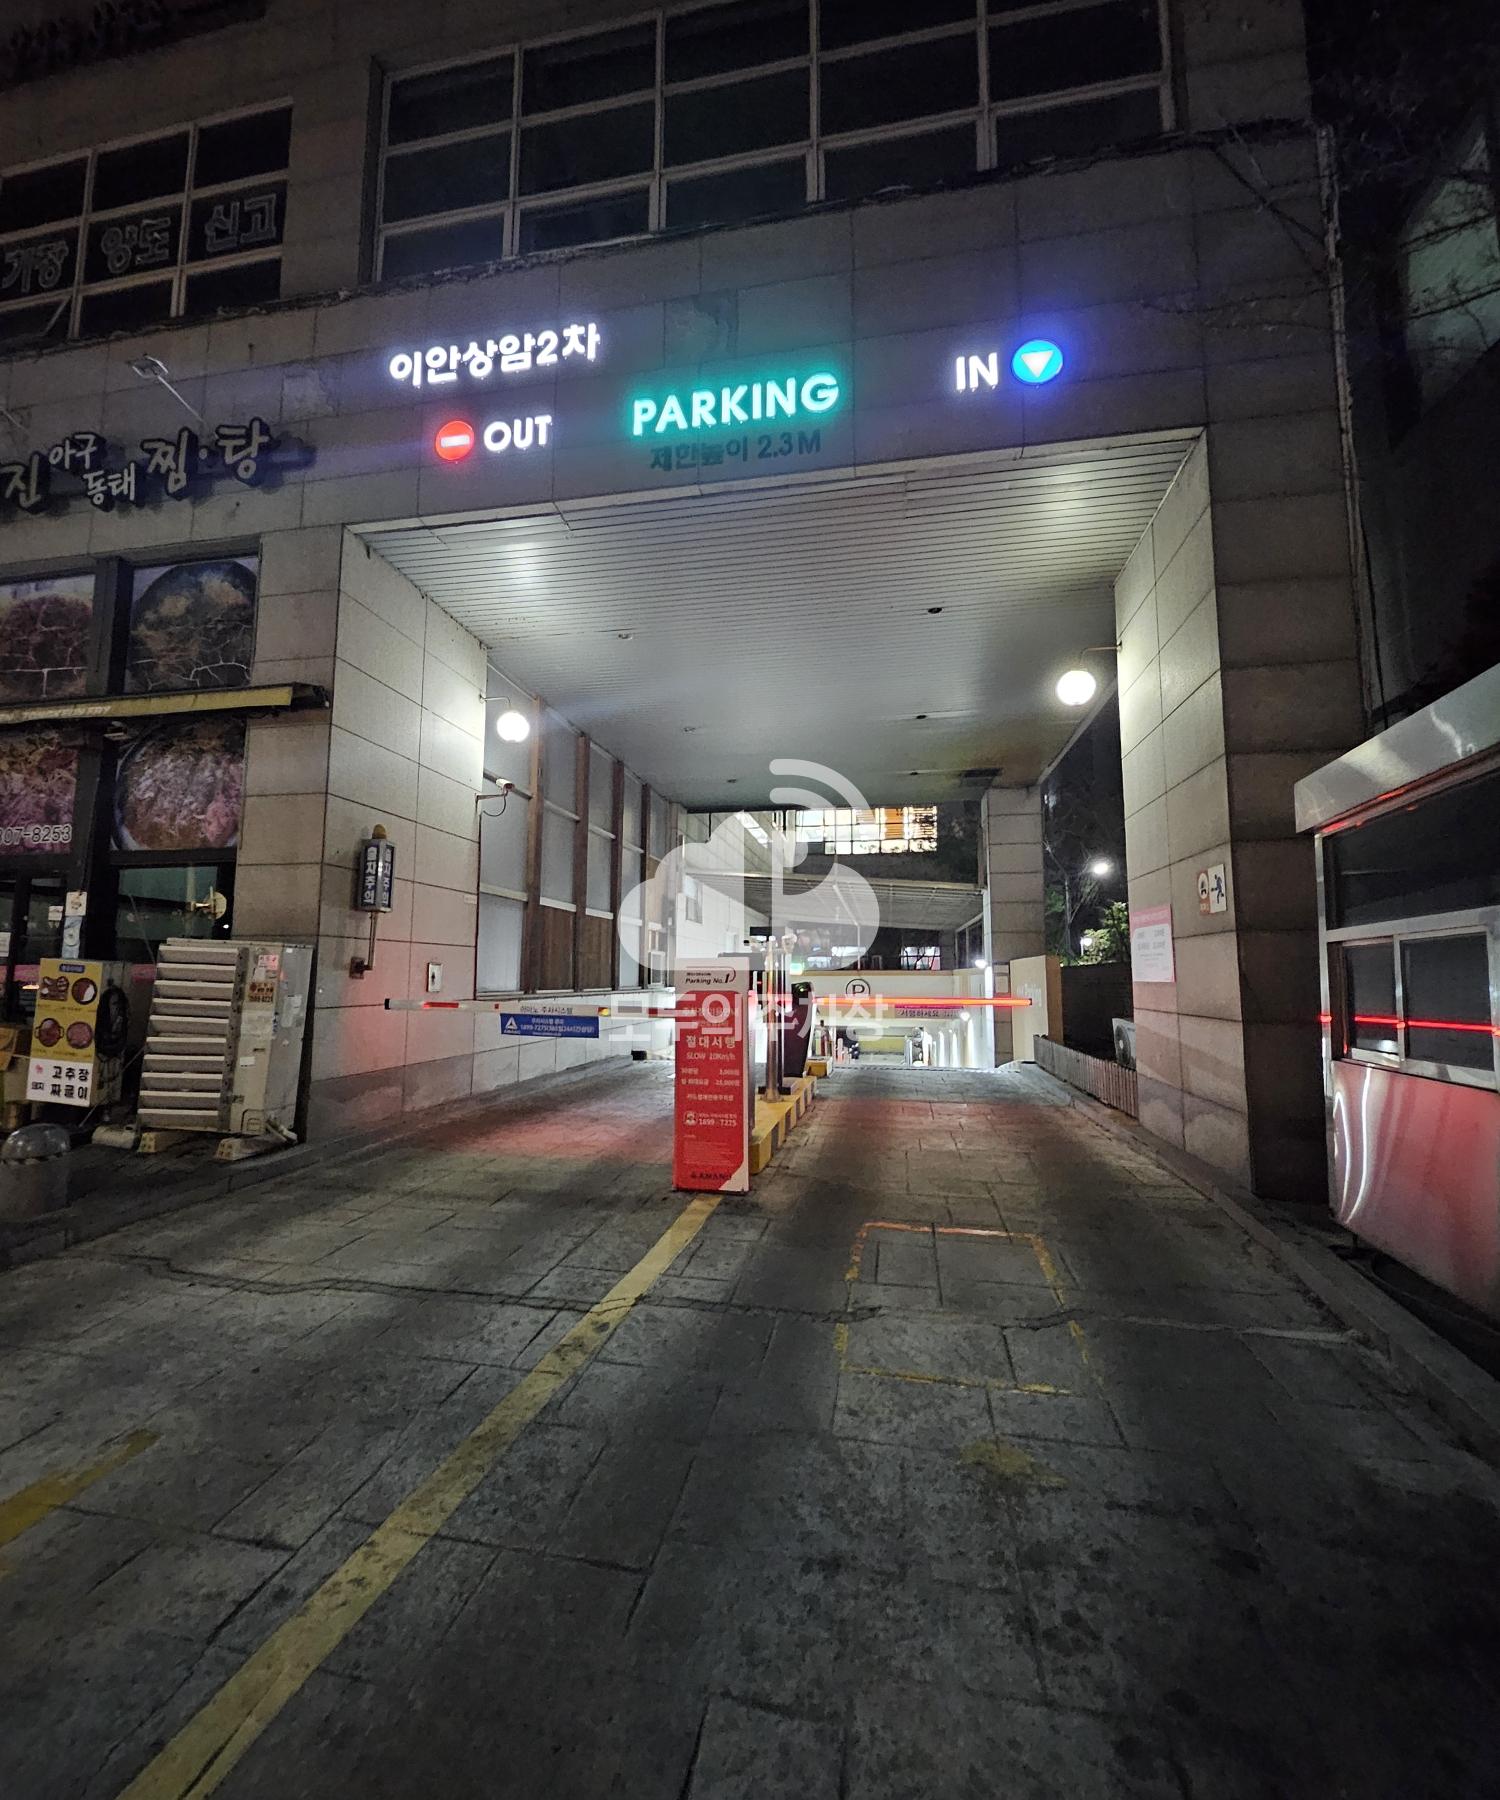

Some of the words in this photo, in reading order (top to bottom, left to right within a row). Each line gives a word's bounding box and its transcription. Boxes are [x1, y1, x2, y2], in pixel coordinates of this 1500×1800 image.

[204, 194, 276, 252] 신고
[389, 321, 601, 388] 이안상암2차
[955, 351, 1000, 392] IN
[631, 371, 840, 437] PARKING
[47, 433, 101, 471] 아구
[483, 413, 553, 453] OUT
[81, 461, 136, 505] 동태
[684, 977, 711, 985] Parking
[685, 1035, 736, 1049] 절대서행
[686, 1051, 706, 1060] SLOW
[52, 1065, 90, 1082] 고추장
